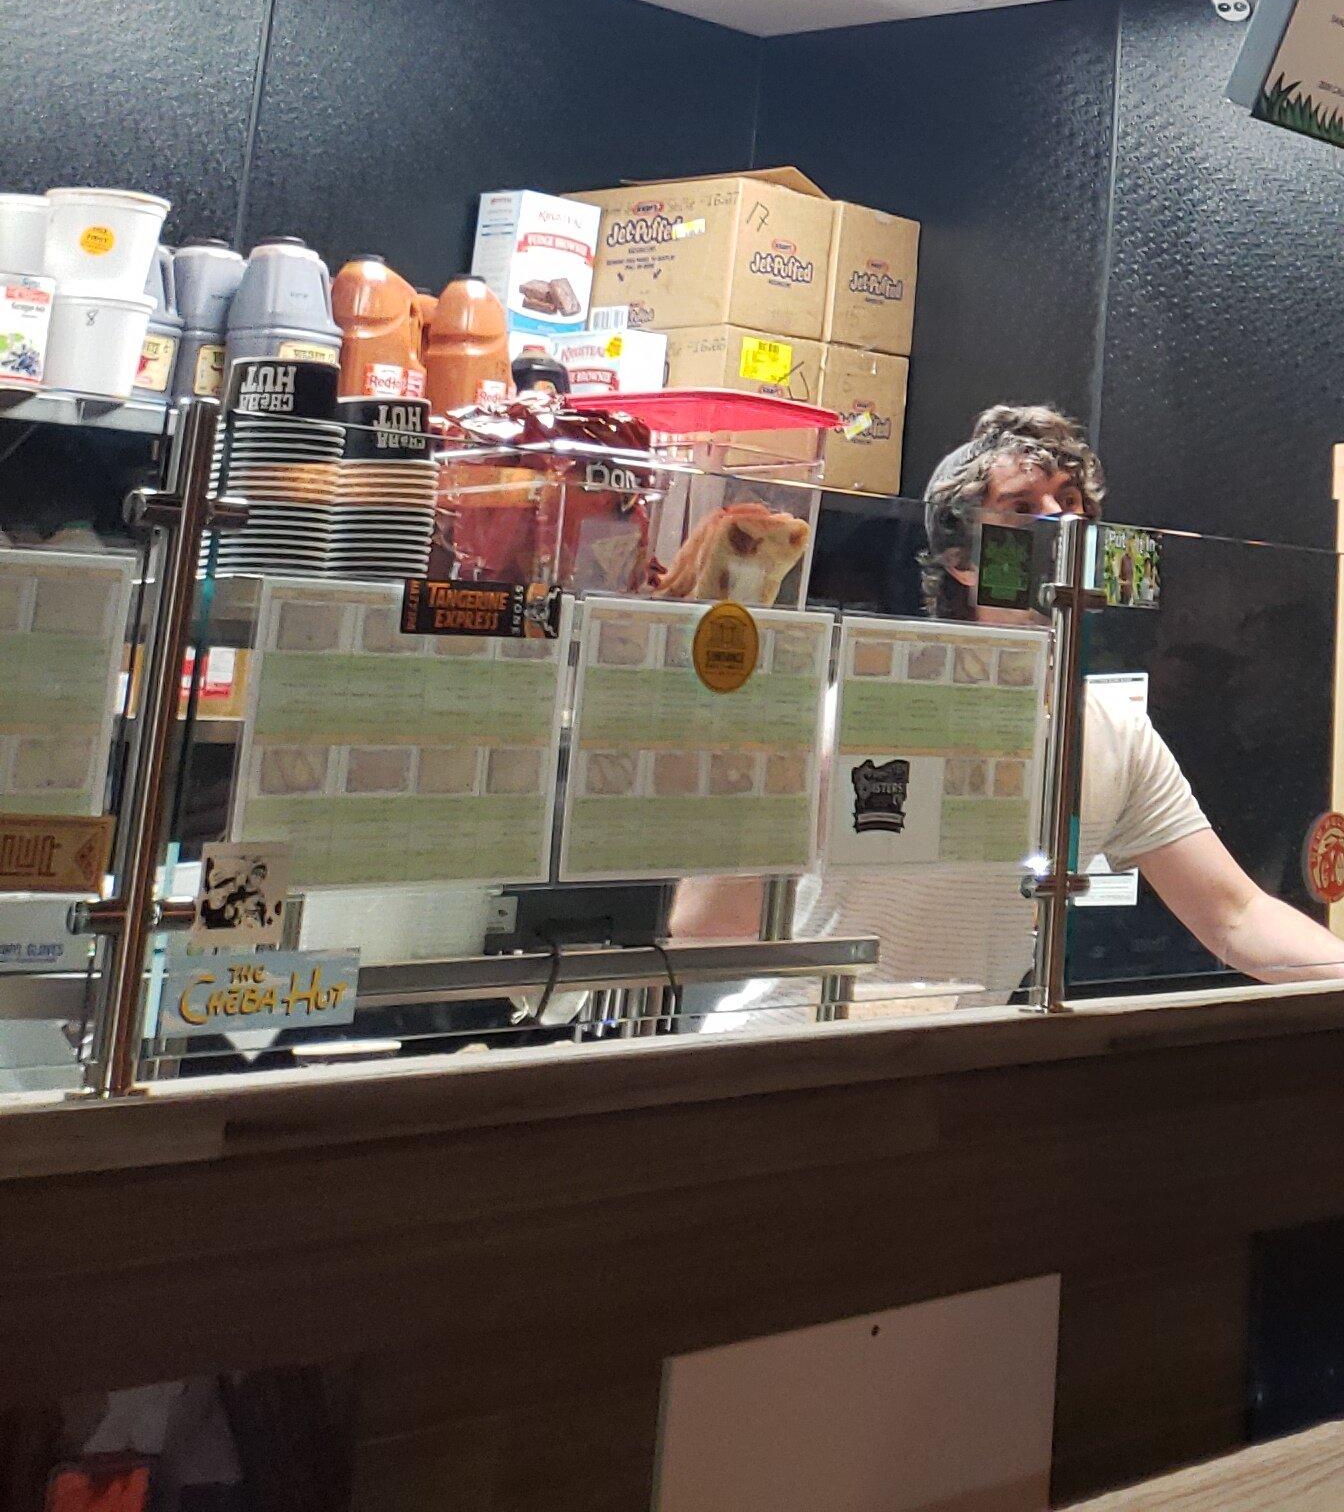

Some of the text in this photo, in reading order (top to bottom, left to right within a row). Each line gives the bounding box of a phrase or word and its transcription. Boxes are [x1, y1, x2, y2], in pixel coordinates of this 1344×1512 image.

[240, 364, 297, 394] HUT
[373, 405, 422, 431] HUT
[427, 582, 510, 610] TANGERINE
[435, 608, 500, 630] EXPRESS
[228, 964, 265, 984] THE
[281, 964, 347, 1017] HUT
